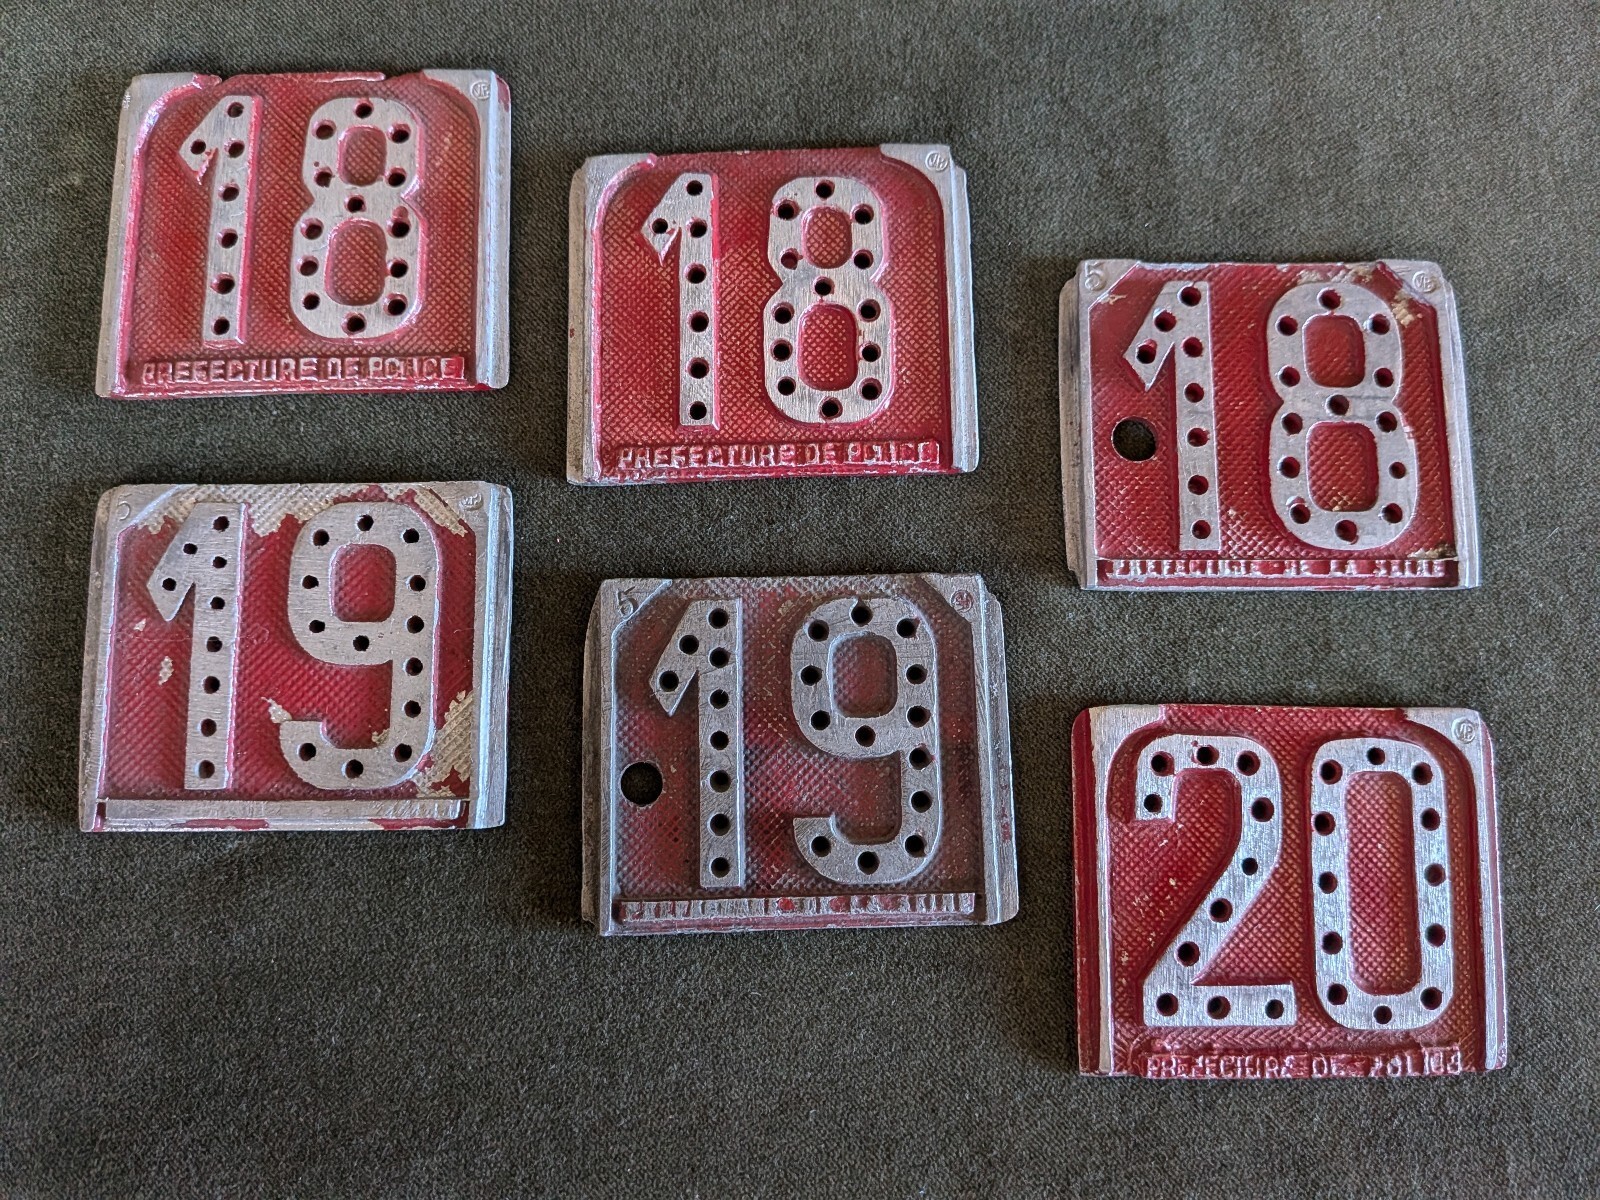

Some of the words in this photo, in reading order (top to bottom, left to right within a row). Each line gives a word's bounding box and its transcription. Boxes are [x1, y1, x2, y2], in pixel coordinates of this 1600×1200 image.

[178, 95, 426, 343] 18
[641, 173, 896, 427] 18
[1084, 262, 1106, 290] 5
[1123, 280, 1419, 551] 18
[147, 502, 442, 790] 19
[616, 587, 638, 618] 5
[649, 598, 942, 887] 19
[1135, 734, 1455, 1030] 20
